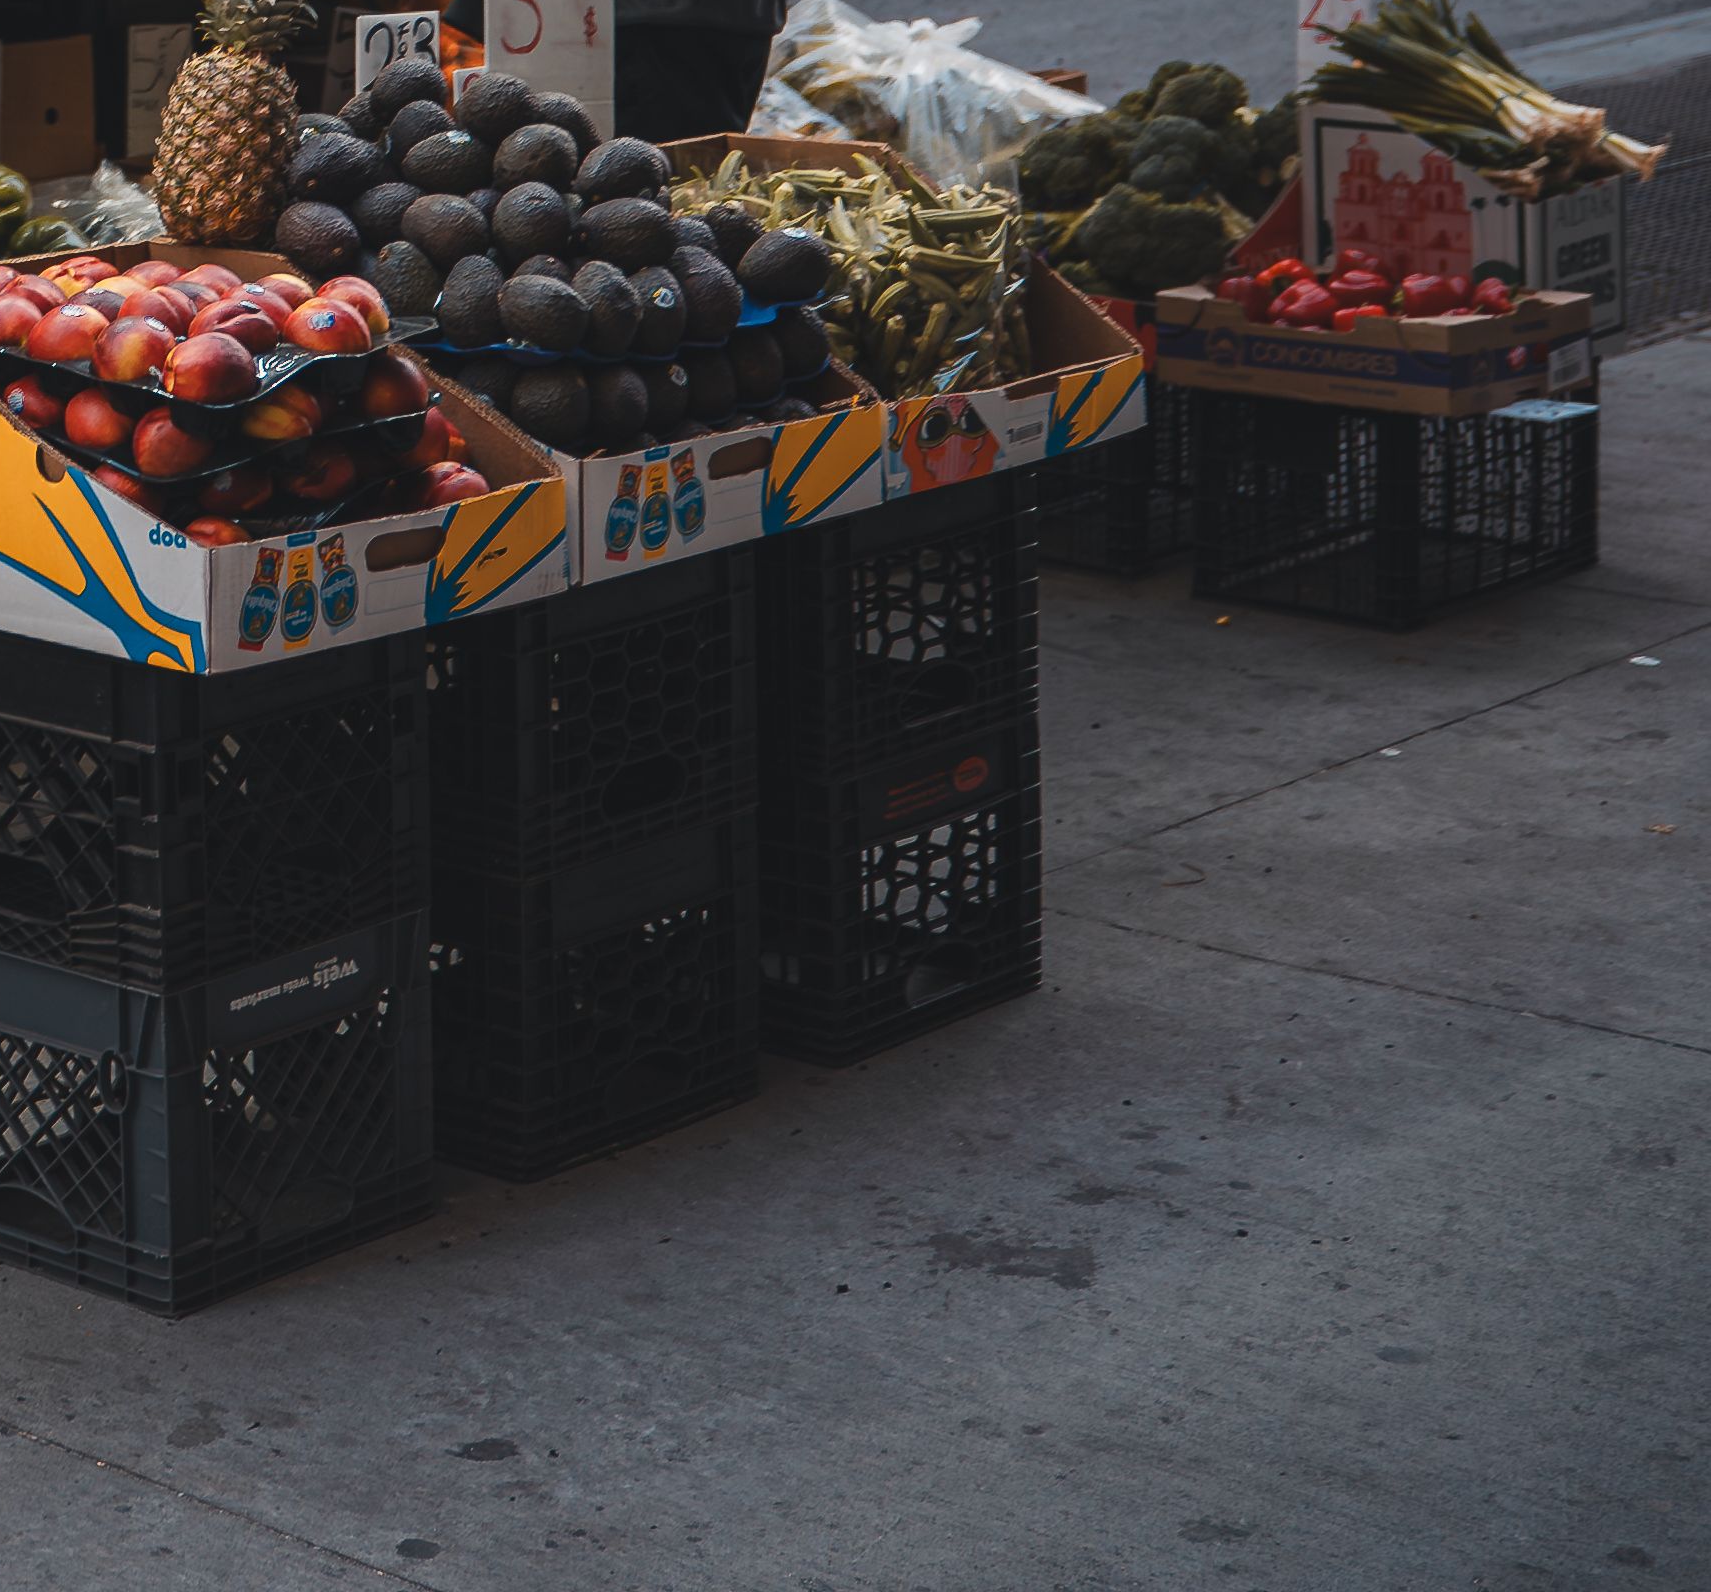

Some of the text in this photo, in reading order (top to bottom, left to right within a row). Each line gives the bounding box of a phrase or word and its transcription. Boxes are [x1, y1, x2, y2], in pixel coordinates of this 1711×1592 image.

[364, 20, 395, 92] 2
[412, 15, 436, 64] 3
[1250, 339, 1398, 377] CONCOMBRES
[313, 958, 359, 989] weis
